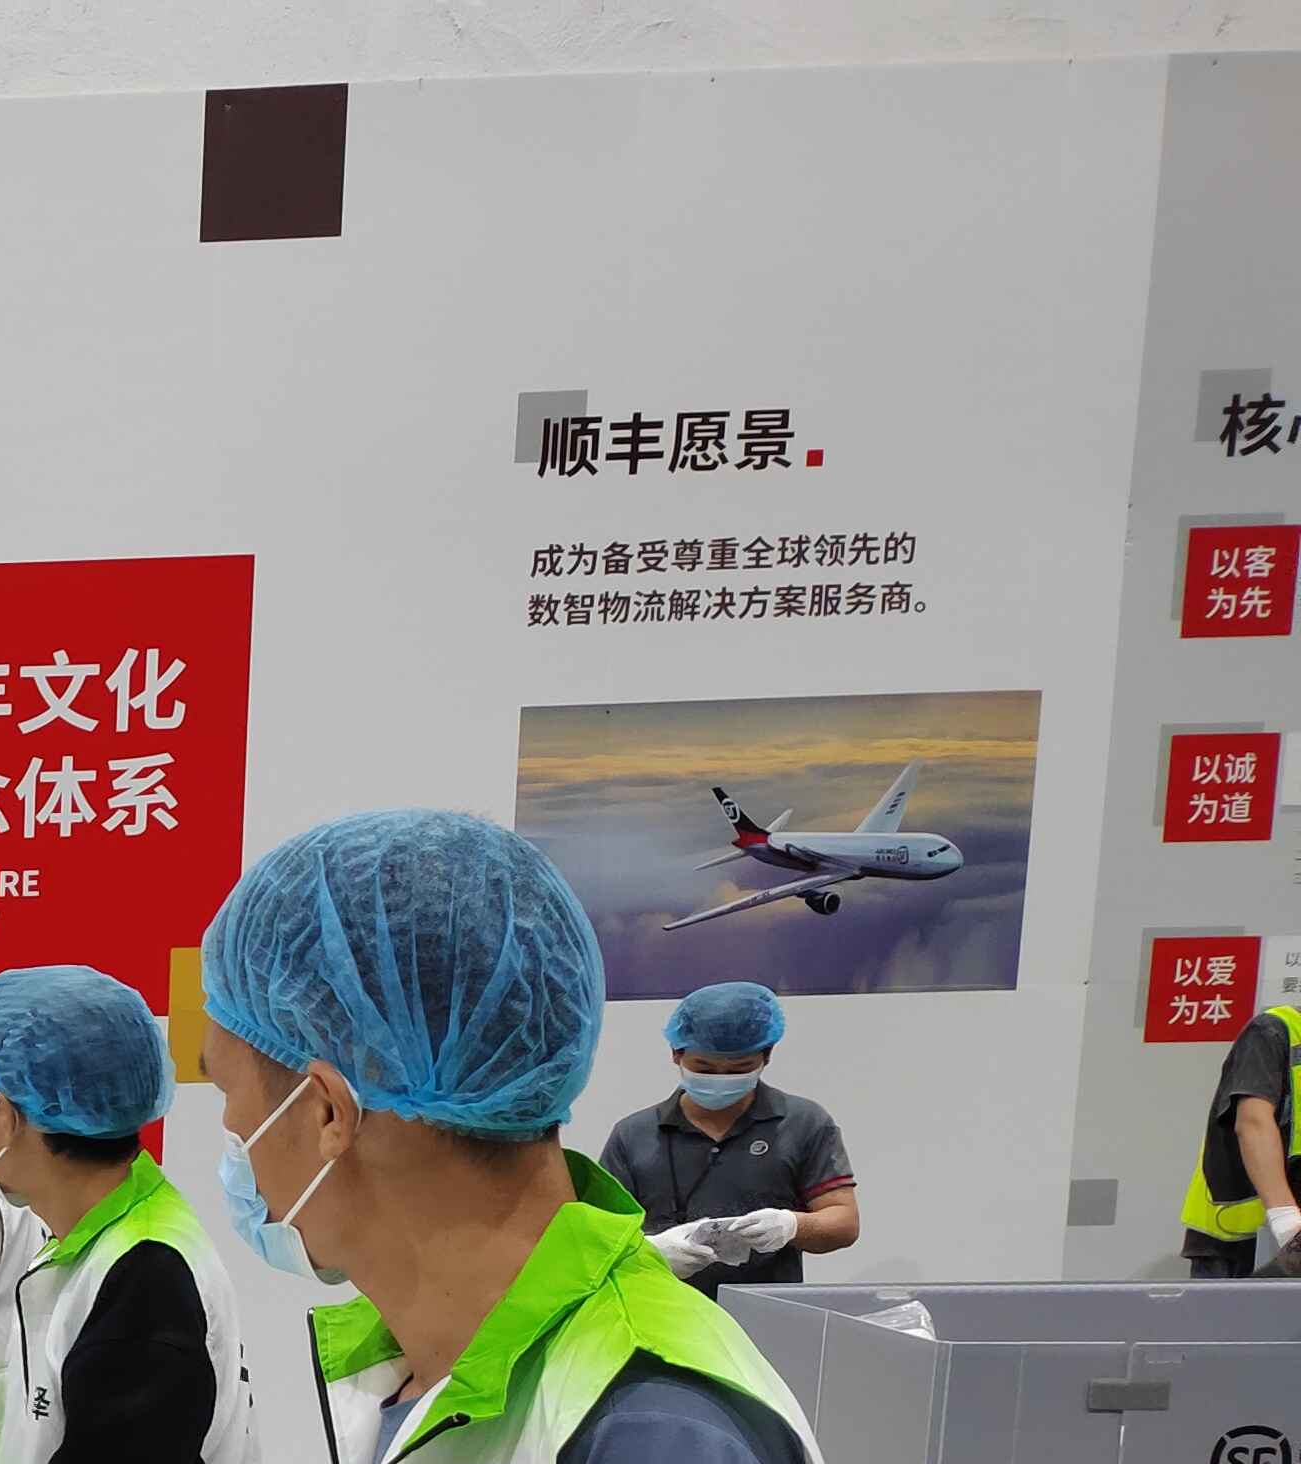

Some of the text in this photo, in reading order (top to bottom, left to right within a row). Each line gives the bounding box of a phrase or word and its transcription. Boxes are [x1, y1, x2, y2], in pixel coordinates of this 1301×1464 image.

[1219, 393, 1301, 457] 核
[537, 409, 795, 478] 顺丰愿景
[530, 531, 916, 579] 成为备受尊重全球领先的
[1210, 546, 1276, 578] 以客
[526, 581, 927, 627] 数智物流解决方案服务商。
[1205, 586, 1271, 620] 为先
[1192, 752, 1257, 784] 以诚
[1188, 792, 1253, 824] 为道
[1174, 955, 1237, 986] 以爱
[1168, 994, 1233, 1024] 为本
